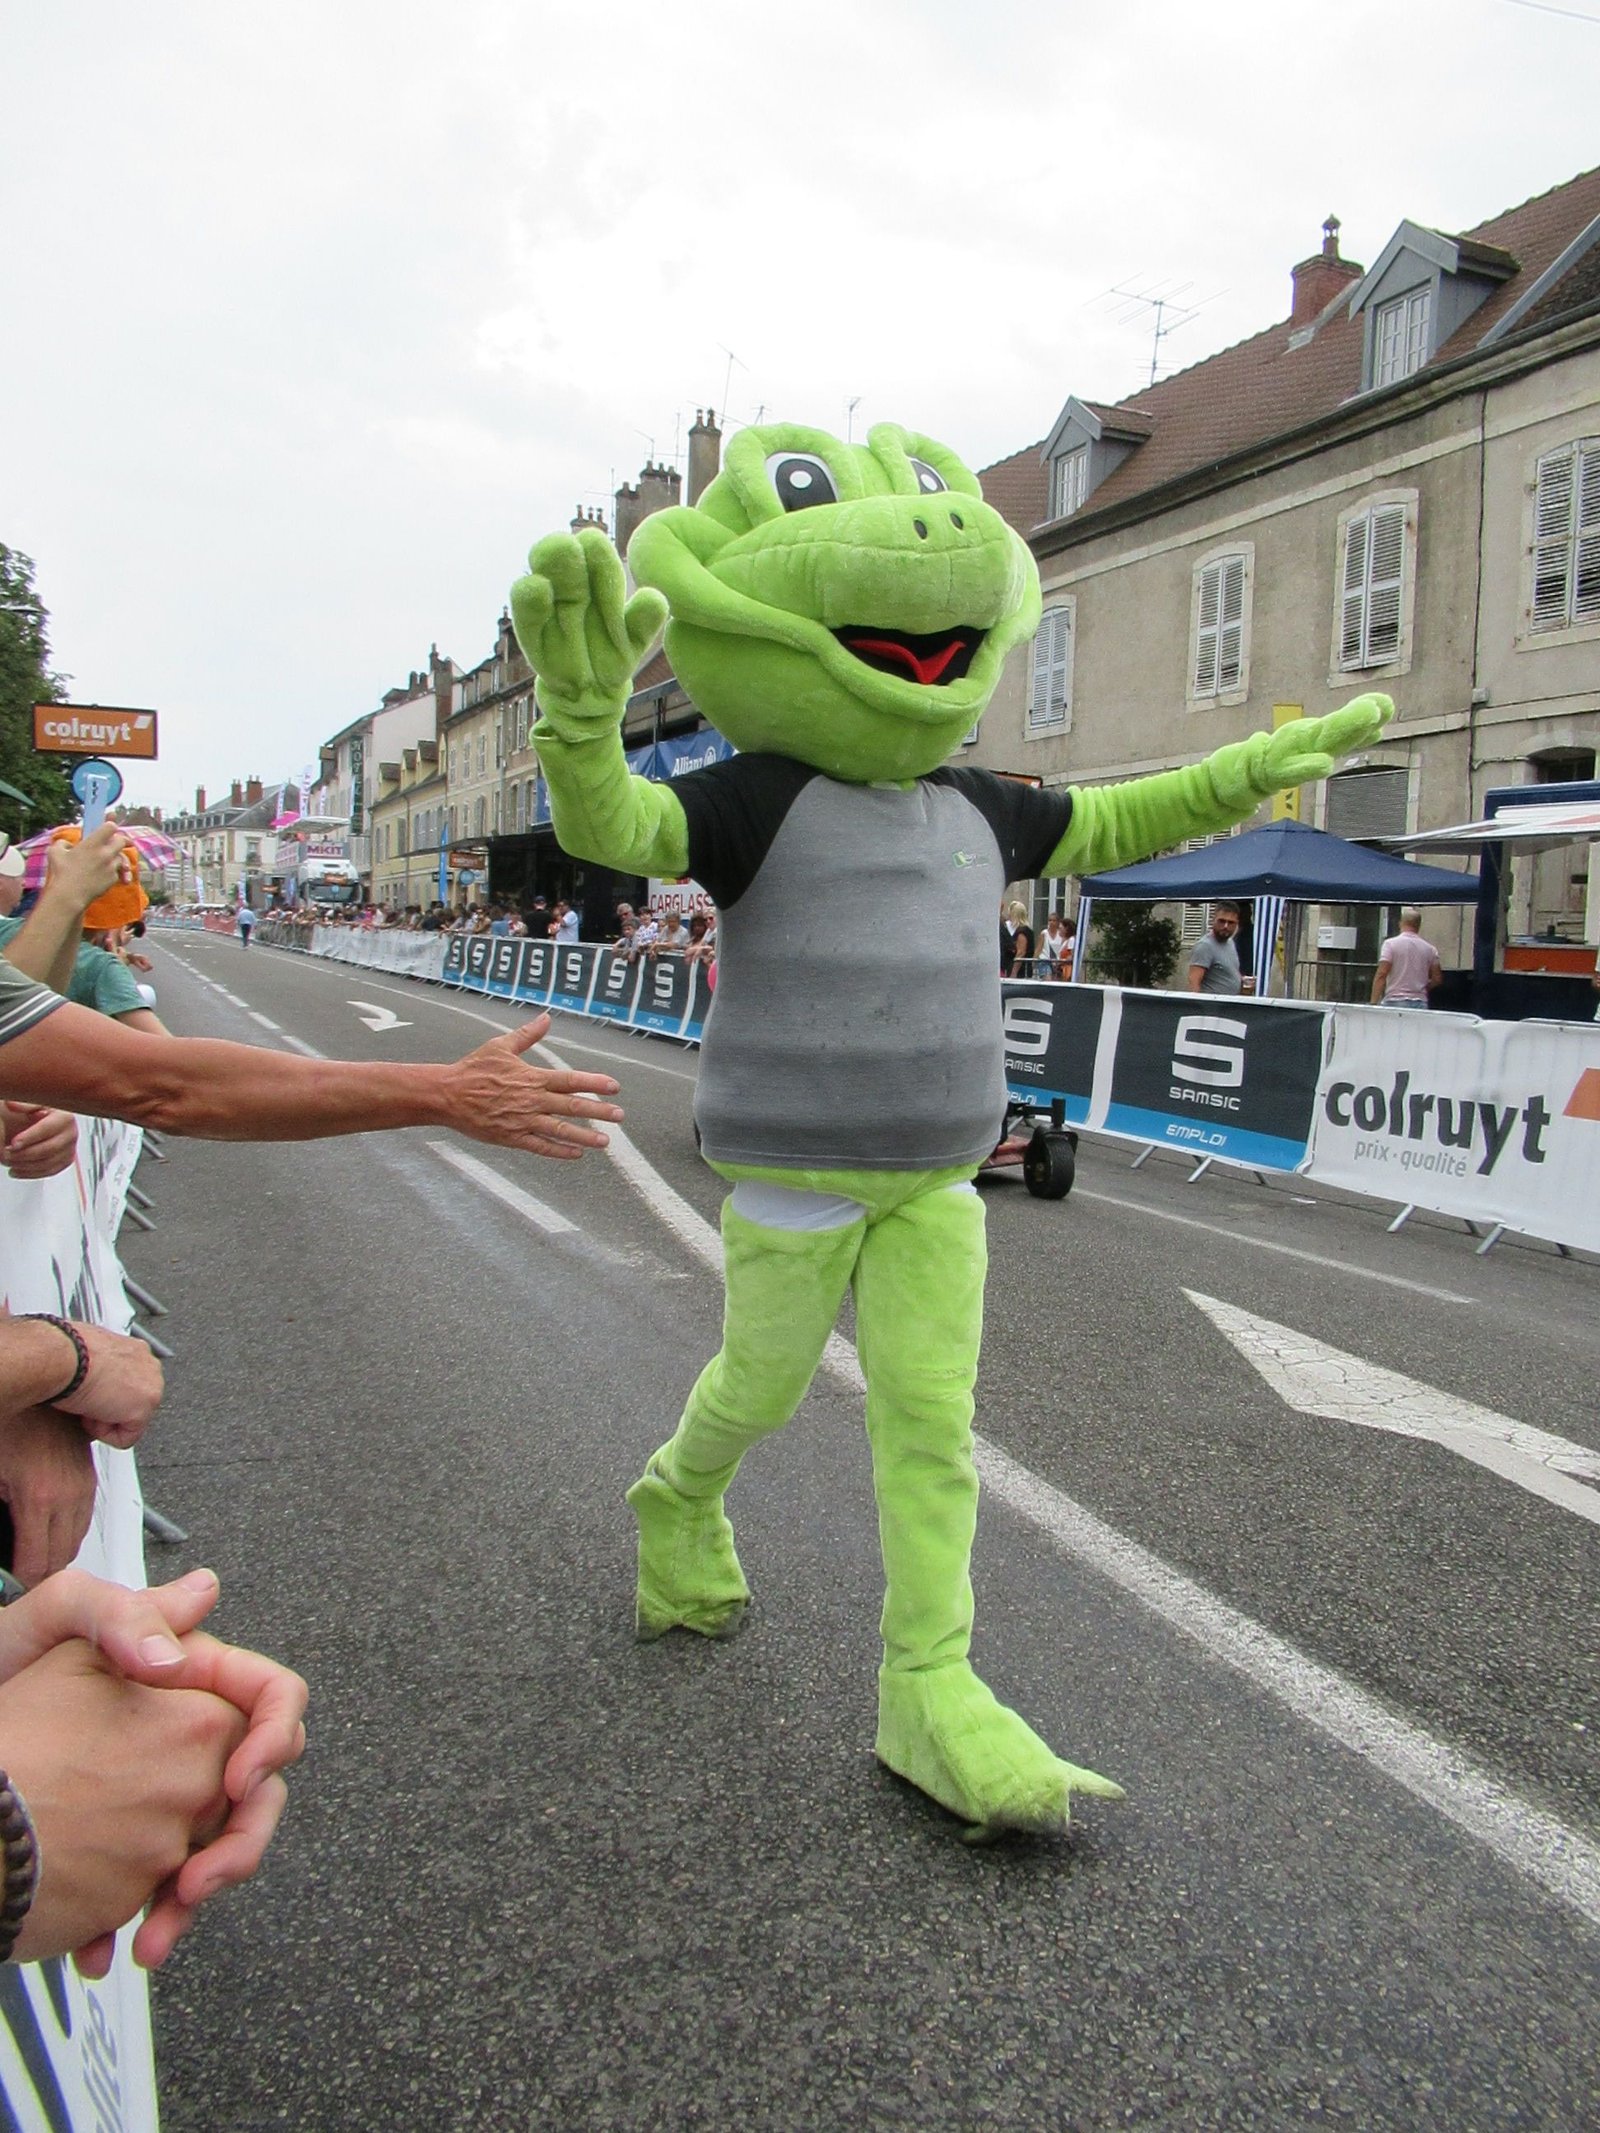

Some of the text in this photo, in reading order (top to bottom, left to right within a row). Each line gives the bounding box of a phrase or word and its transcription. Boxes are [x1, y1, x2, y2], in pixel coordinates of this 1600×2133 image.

[44, 717, 132, 746] colruyt
[1172, 1015, 1248, 1088] S
[1169, 1086, 1241, 1111] SAMSIC
[1166, 1123, 1227, 1148] EMPLOI
[1325, 1070, 1551, 1177] colruyt
[1354, 1139, 1468, 1178] prix qualité
